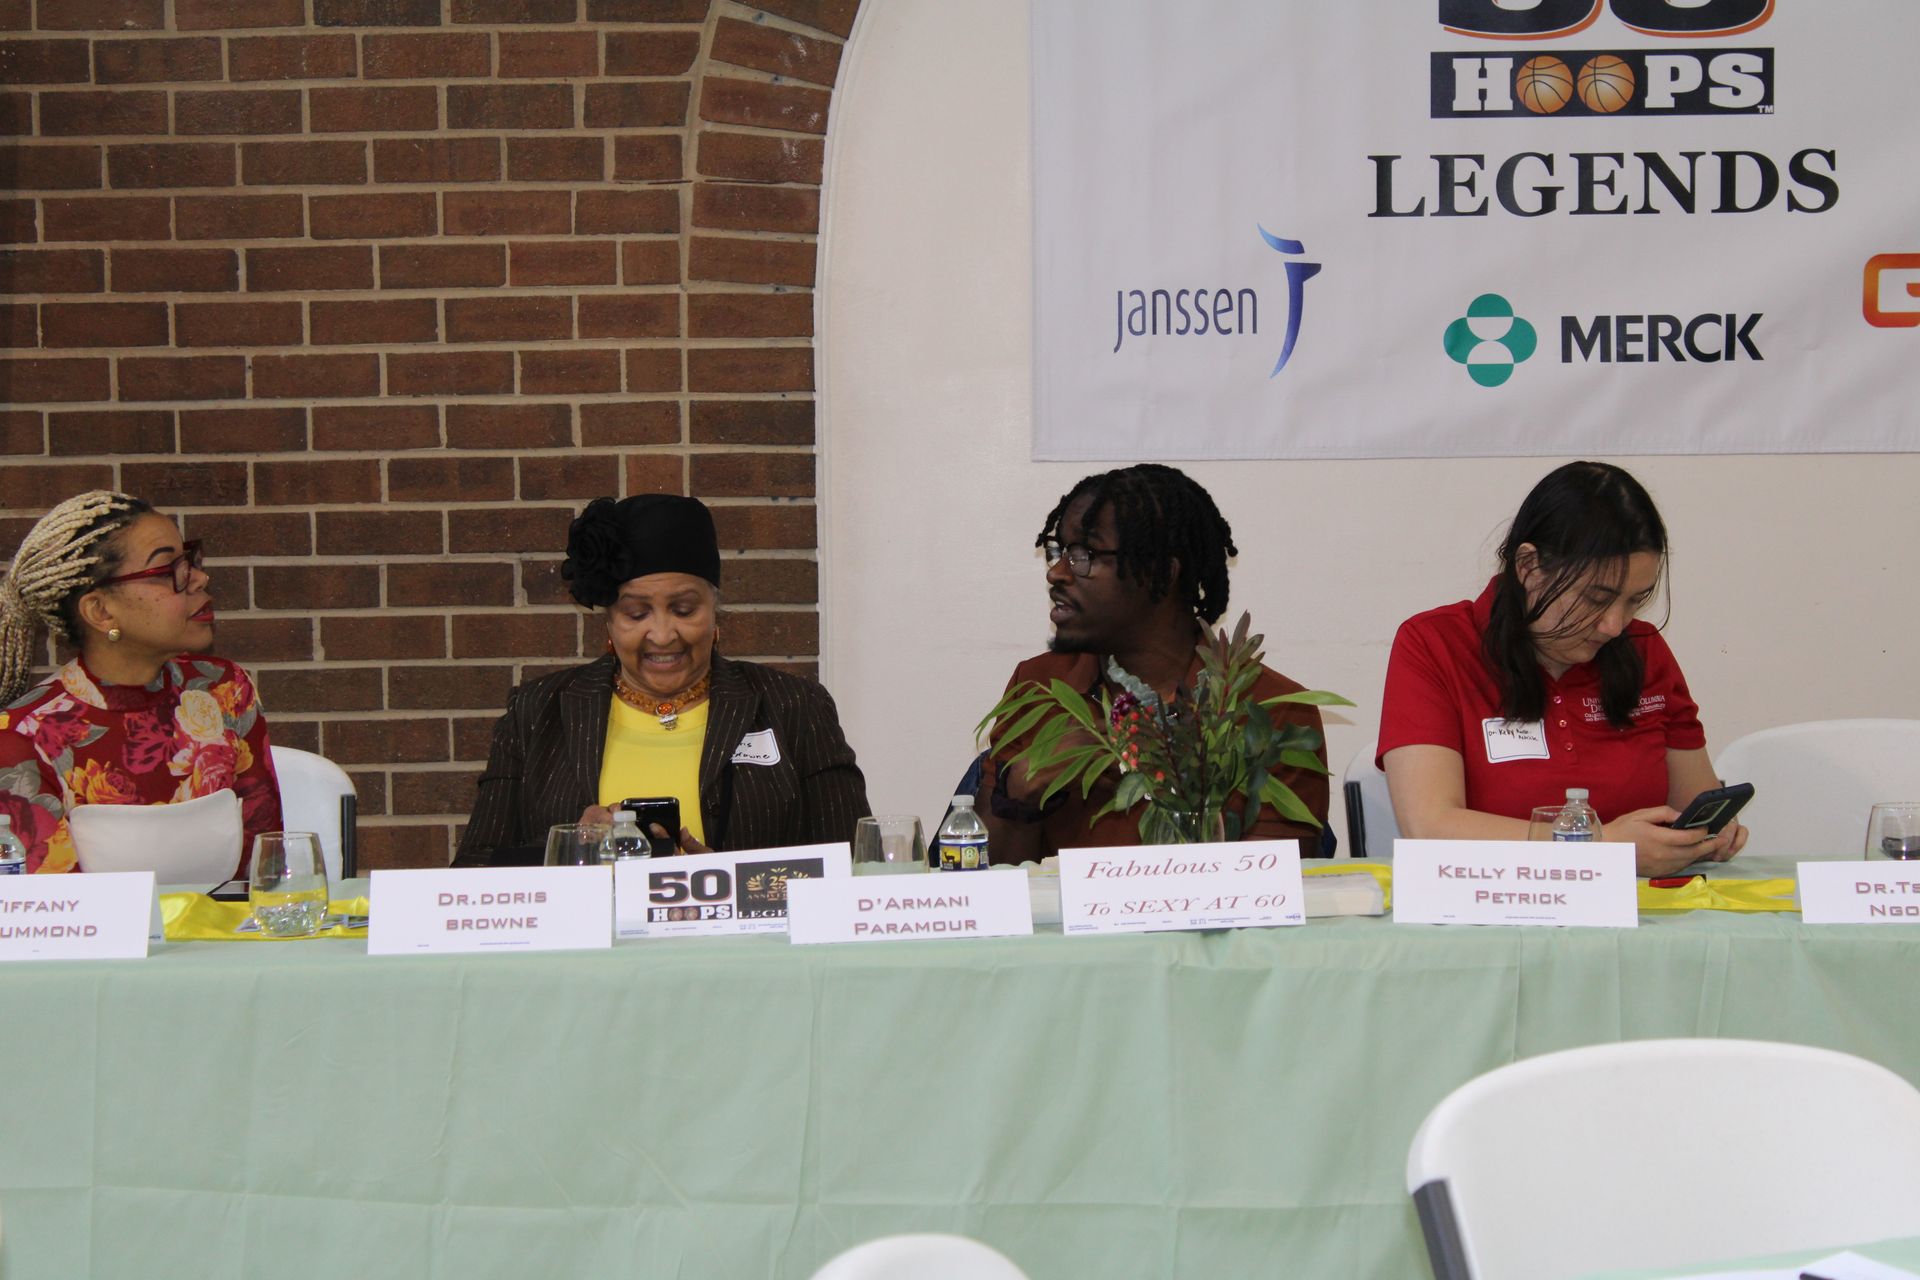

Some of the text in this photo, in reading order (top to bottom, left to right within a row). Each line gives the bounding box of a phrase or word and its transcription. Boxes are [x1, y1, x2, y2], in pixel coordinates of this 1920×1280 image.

[1452, 52, 1766, 114] HOOPS
[1367, 147, 1841, 219] LEGENDS
[1113, 288, 1258, 354] janssen
[1560, 313, 1764, 364] MERCK
[1084, 853, 1278, 880] Fabulous 50
[648, 869, 733, 905] 50
[1083, 894, 1287, 916] To SEXY AT 60
[446, 917, 539, 931] BROWNE
[652, 905, 731, 922] HOOPS
